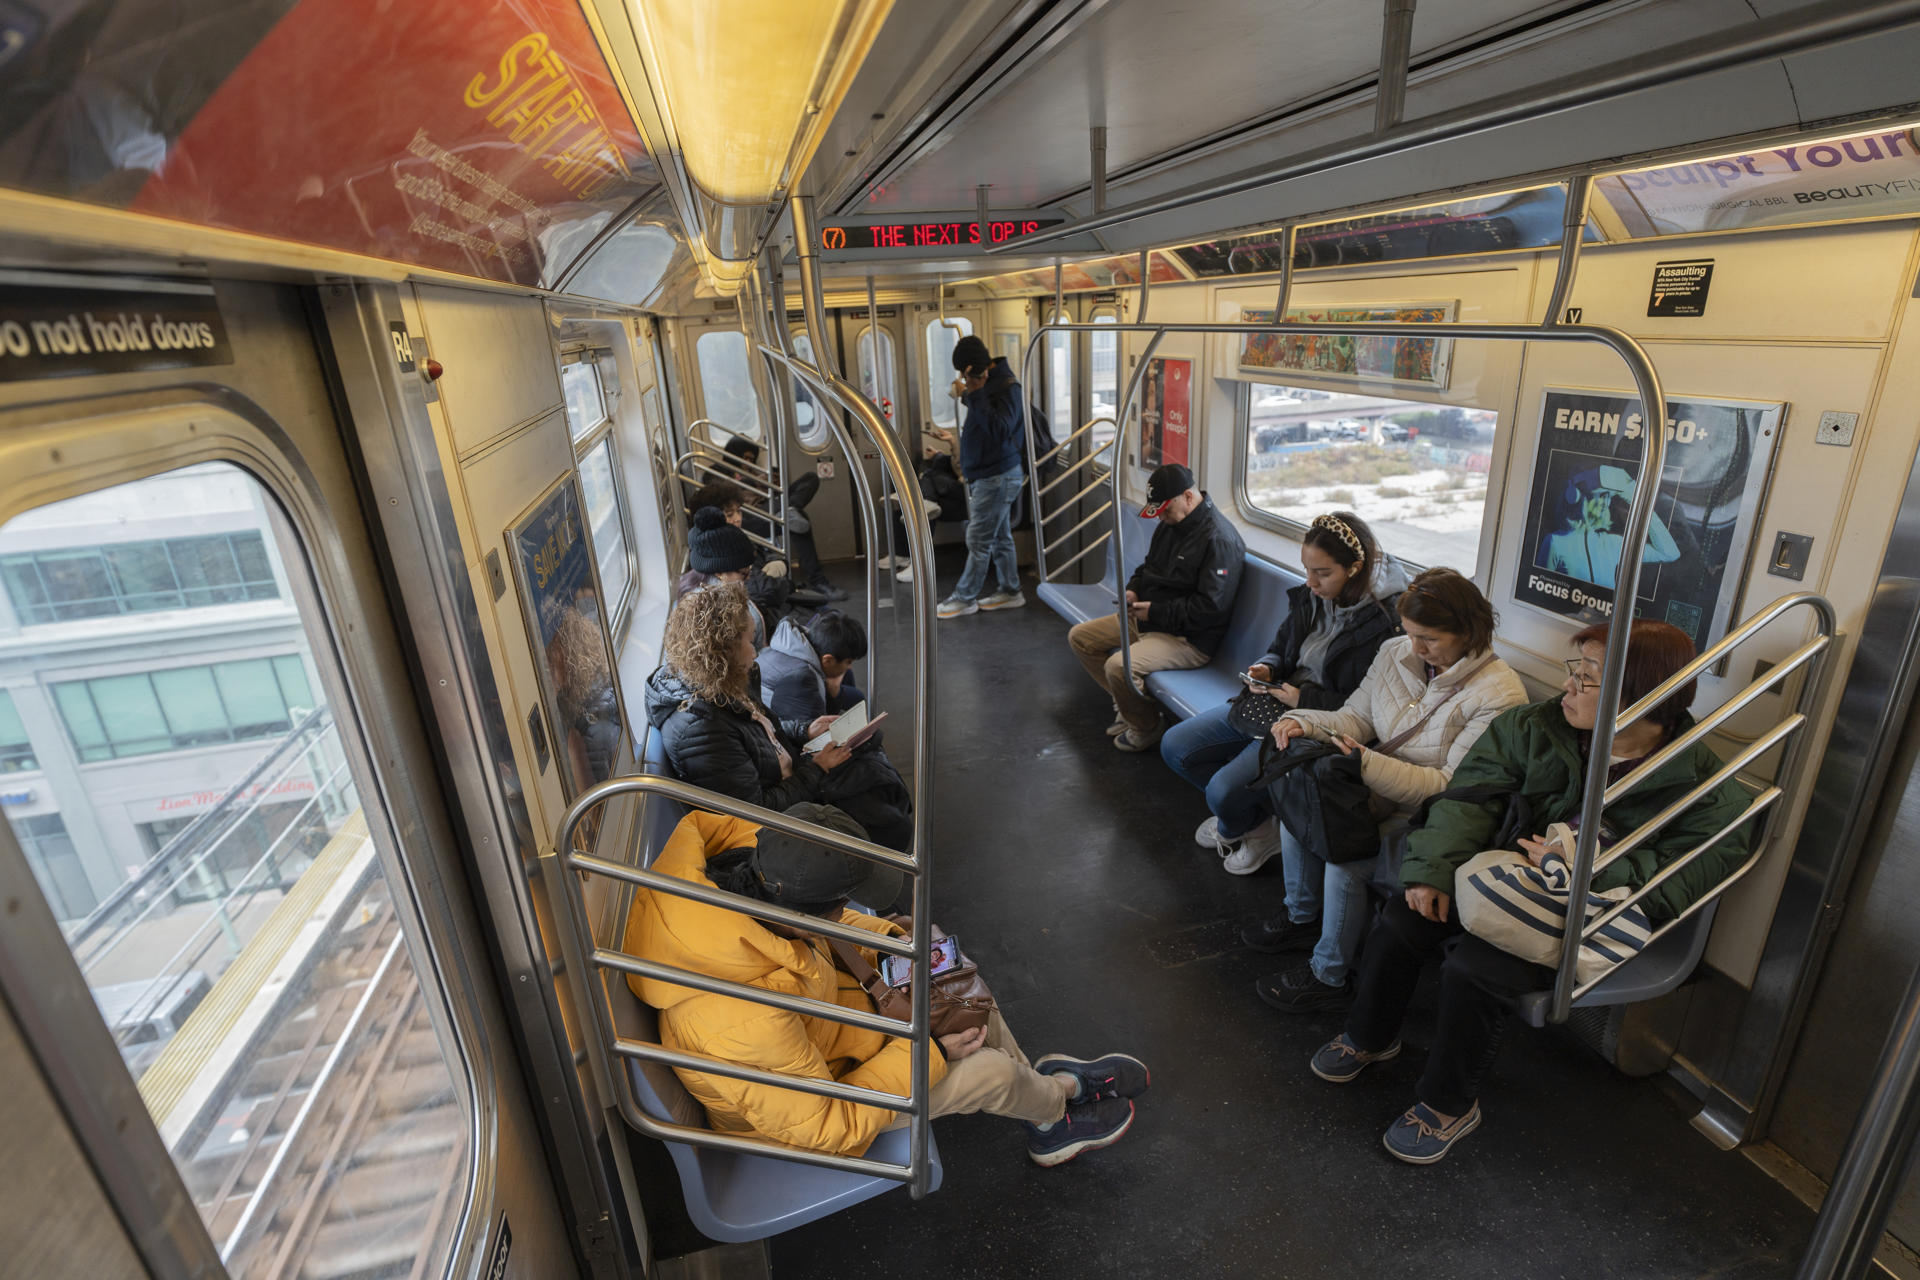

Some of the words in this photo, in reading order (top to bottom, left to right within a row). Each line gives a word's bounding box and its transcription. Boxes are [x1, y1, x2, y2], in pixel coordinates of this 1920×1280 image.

[464, 32, 595, 160] START
[405, 127, 438, 159] Your
[1771, 132, 1906, 172] Your
[1766, 196, 1788, 205] BBL
[869, 225, 907, 247] THE
[913, 223, 961, 246] NEXT
[969, 221, 1016, 244] SOP
[1659, 267, 1707, 277] Assaulting
[1655, 293, 1664, 306] 7
[0, 319, 30, 358] o
[31, 313, 92, 354] not
[84, 312, 151, 352] hold
[151, 314, 215, 350] doors
[391, 331, 413, 362] R4
[1169, 410, 1183, 424] Only
[1554, 407, 1620, 435] EARN
[1624, 413, 1708, 443] $50+
[1528, 574, 1569, 600] Focus
